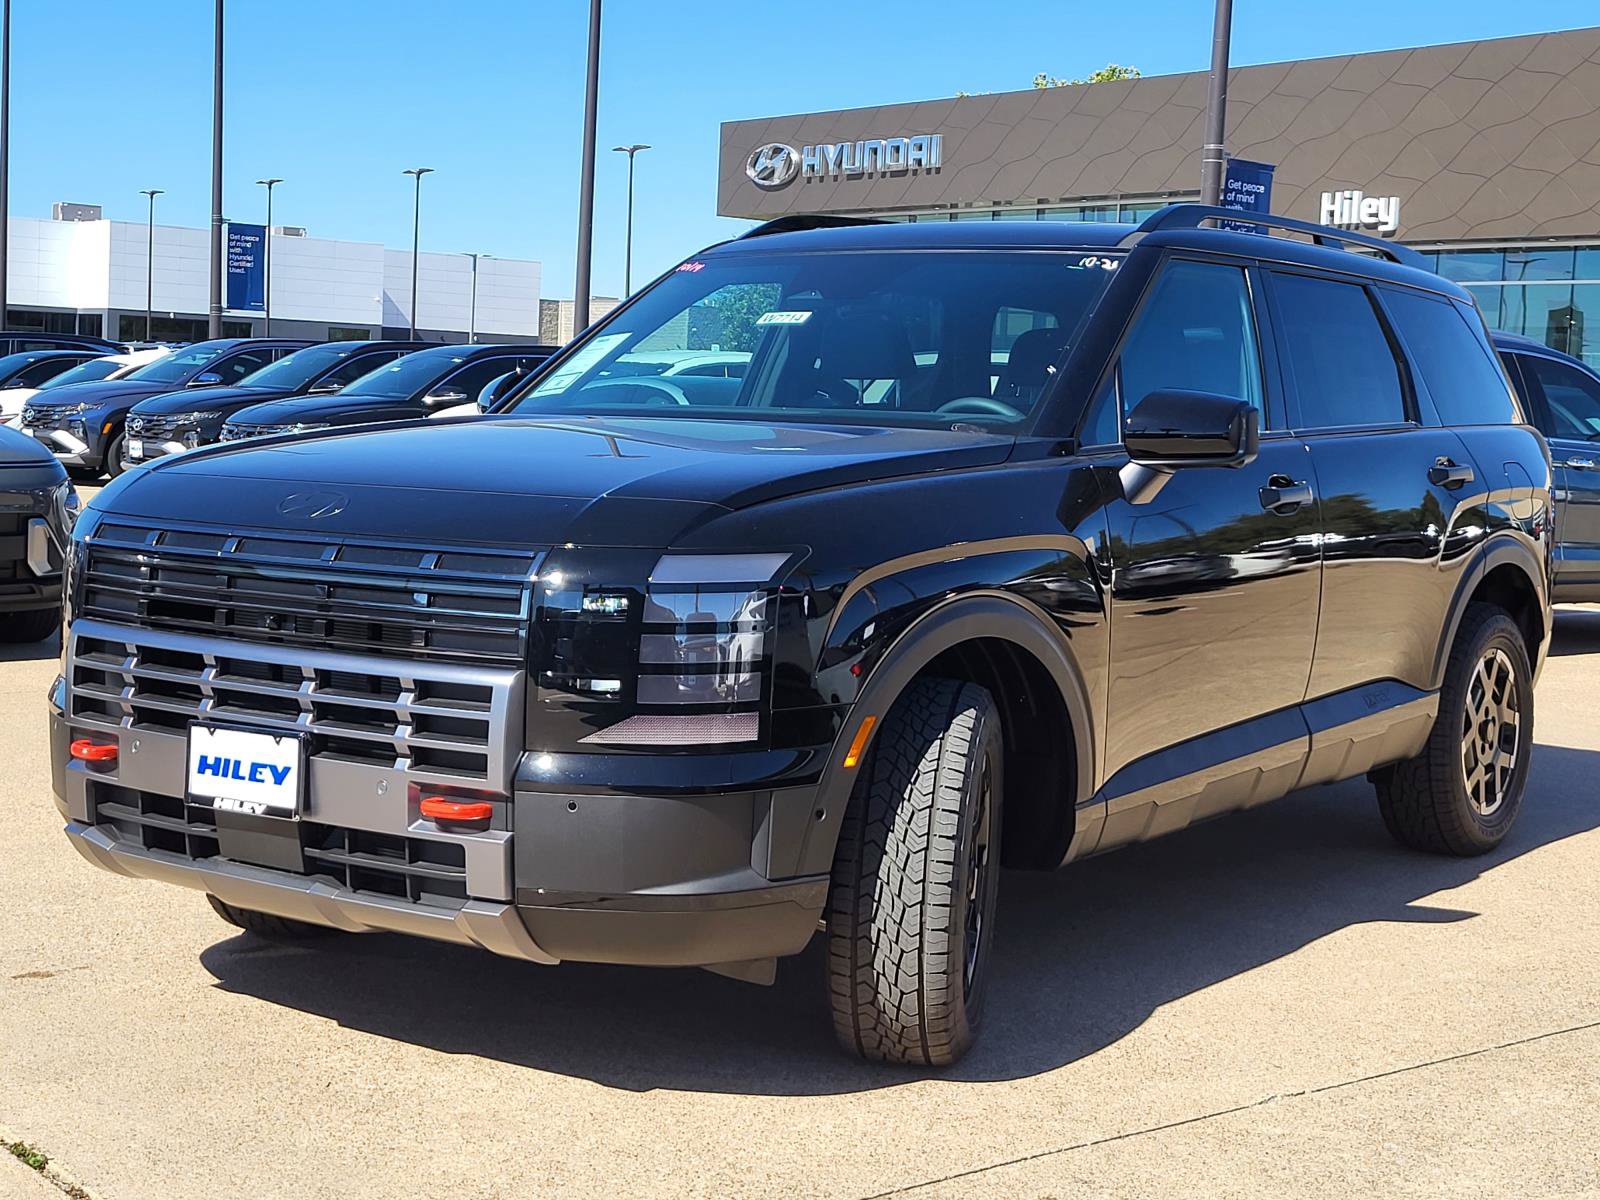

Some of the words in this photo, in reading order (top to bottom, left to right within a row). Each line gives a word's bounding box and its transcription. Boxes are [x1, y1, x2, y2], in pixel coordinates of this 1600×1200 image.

[802, 133, 943, 178] HYUNDAI
[1228, 179, 1242, 190] Get
[1243, 183, 1265, 193] peace
[1226, 191, 1235, 201] of
[1236, 192, 1255, 203] mind
[1320, 190, 1400, 231] Hiley
[229, 260, 254, 268] Certified
[197, 754, 292, 786] HILEY
[212, 797, 268, 815] HILEY
